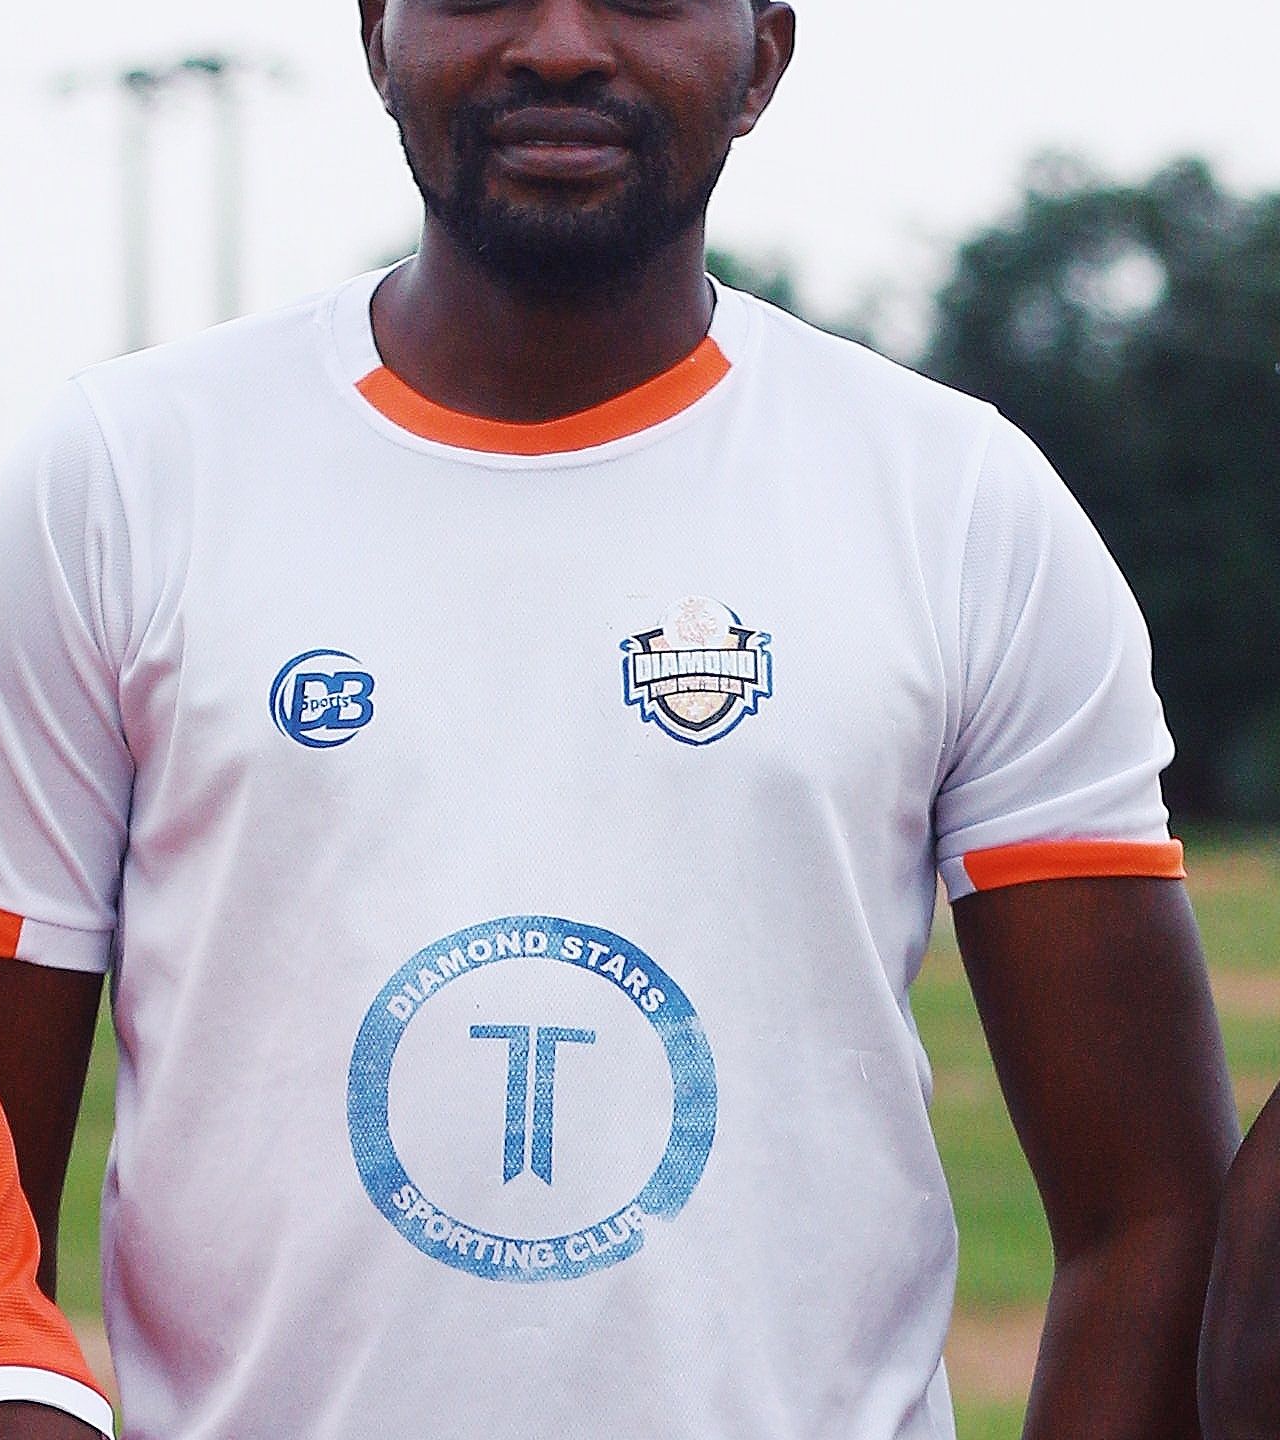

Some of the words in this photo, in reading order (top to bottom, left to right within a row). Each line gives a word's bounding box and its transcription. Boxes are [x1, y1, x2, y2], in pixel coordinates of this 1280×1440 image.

[635, 650, 756, 683] DIAMOND
[385, 929, 549, 1023] DIAMOND
[560, 935, 667, 1015] STARS
[390, 1184, 558, 1270] SPORTING
